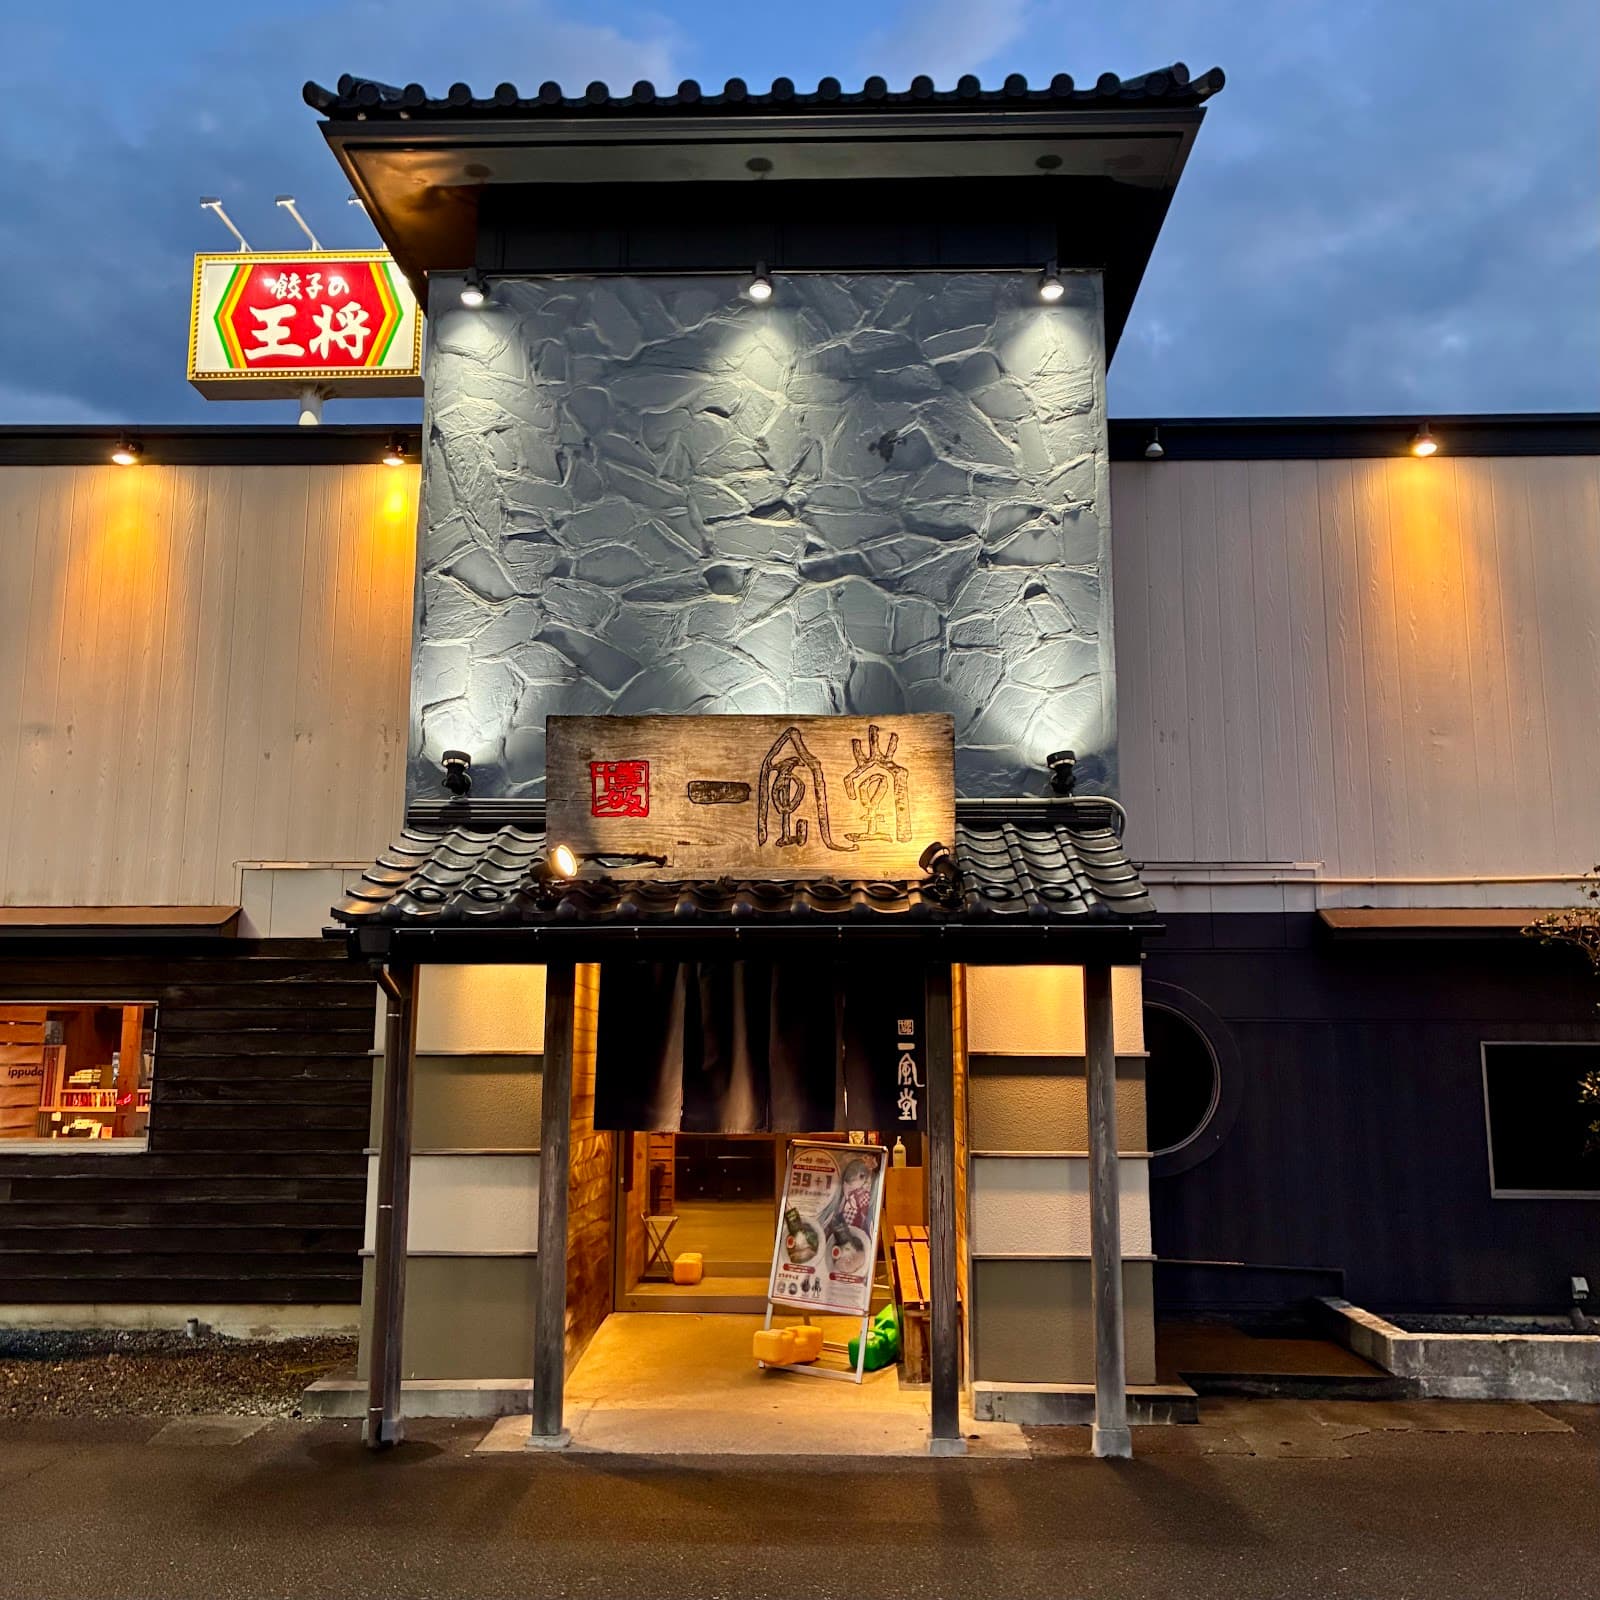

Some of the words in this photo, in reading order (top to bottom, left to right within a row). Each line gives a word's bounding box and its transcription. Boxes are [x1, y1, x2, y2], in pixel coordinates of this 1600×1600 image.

[270, 272, 349, 300] 餃子の
[244, 301, 371, 360] 王将
[687, 724, 913, 852] 一風堂
[8, 1066, 44, 1079] ippudo
[897, 1042, 926, 1121] 一風堂
